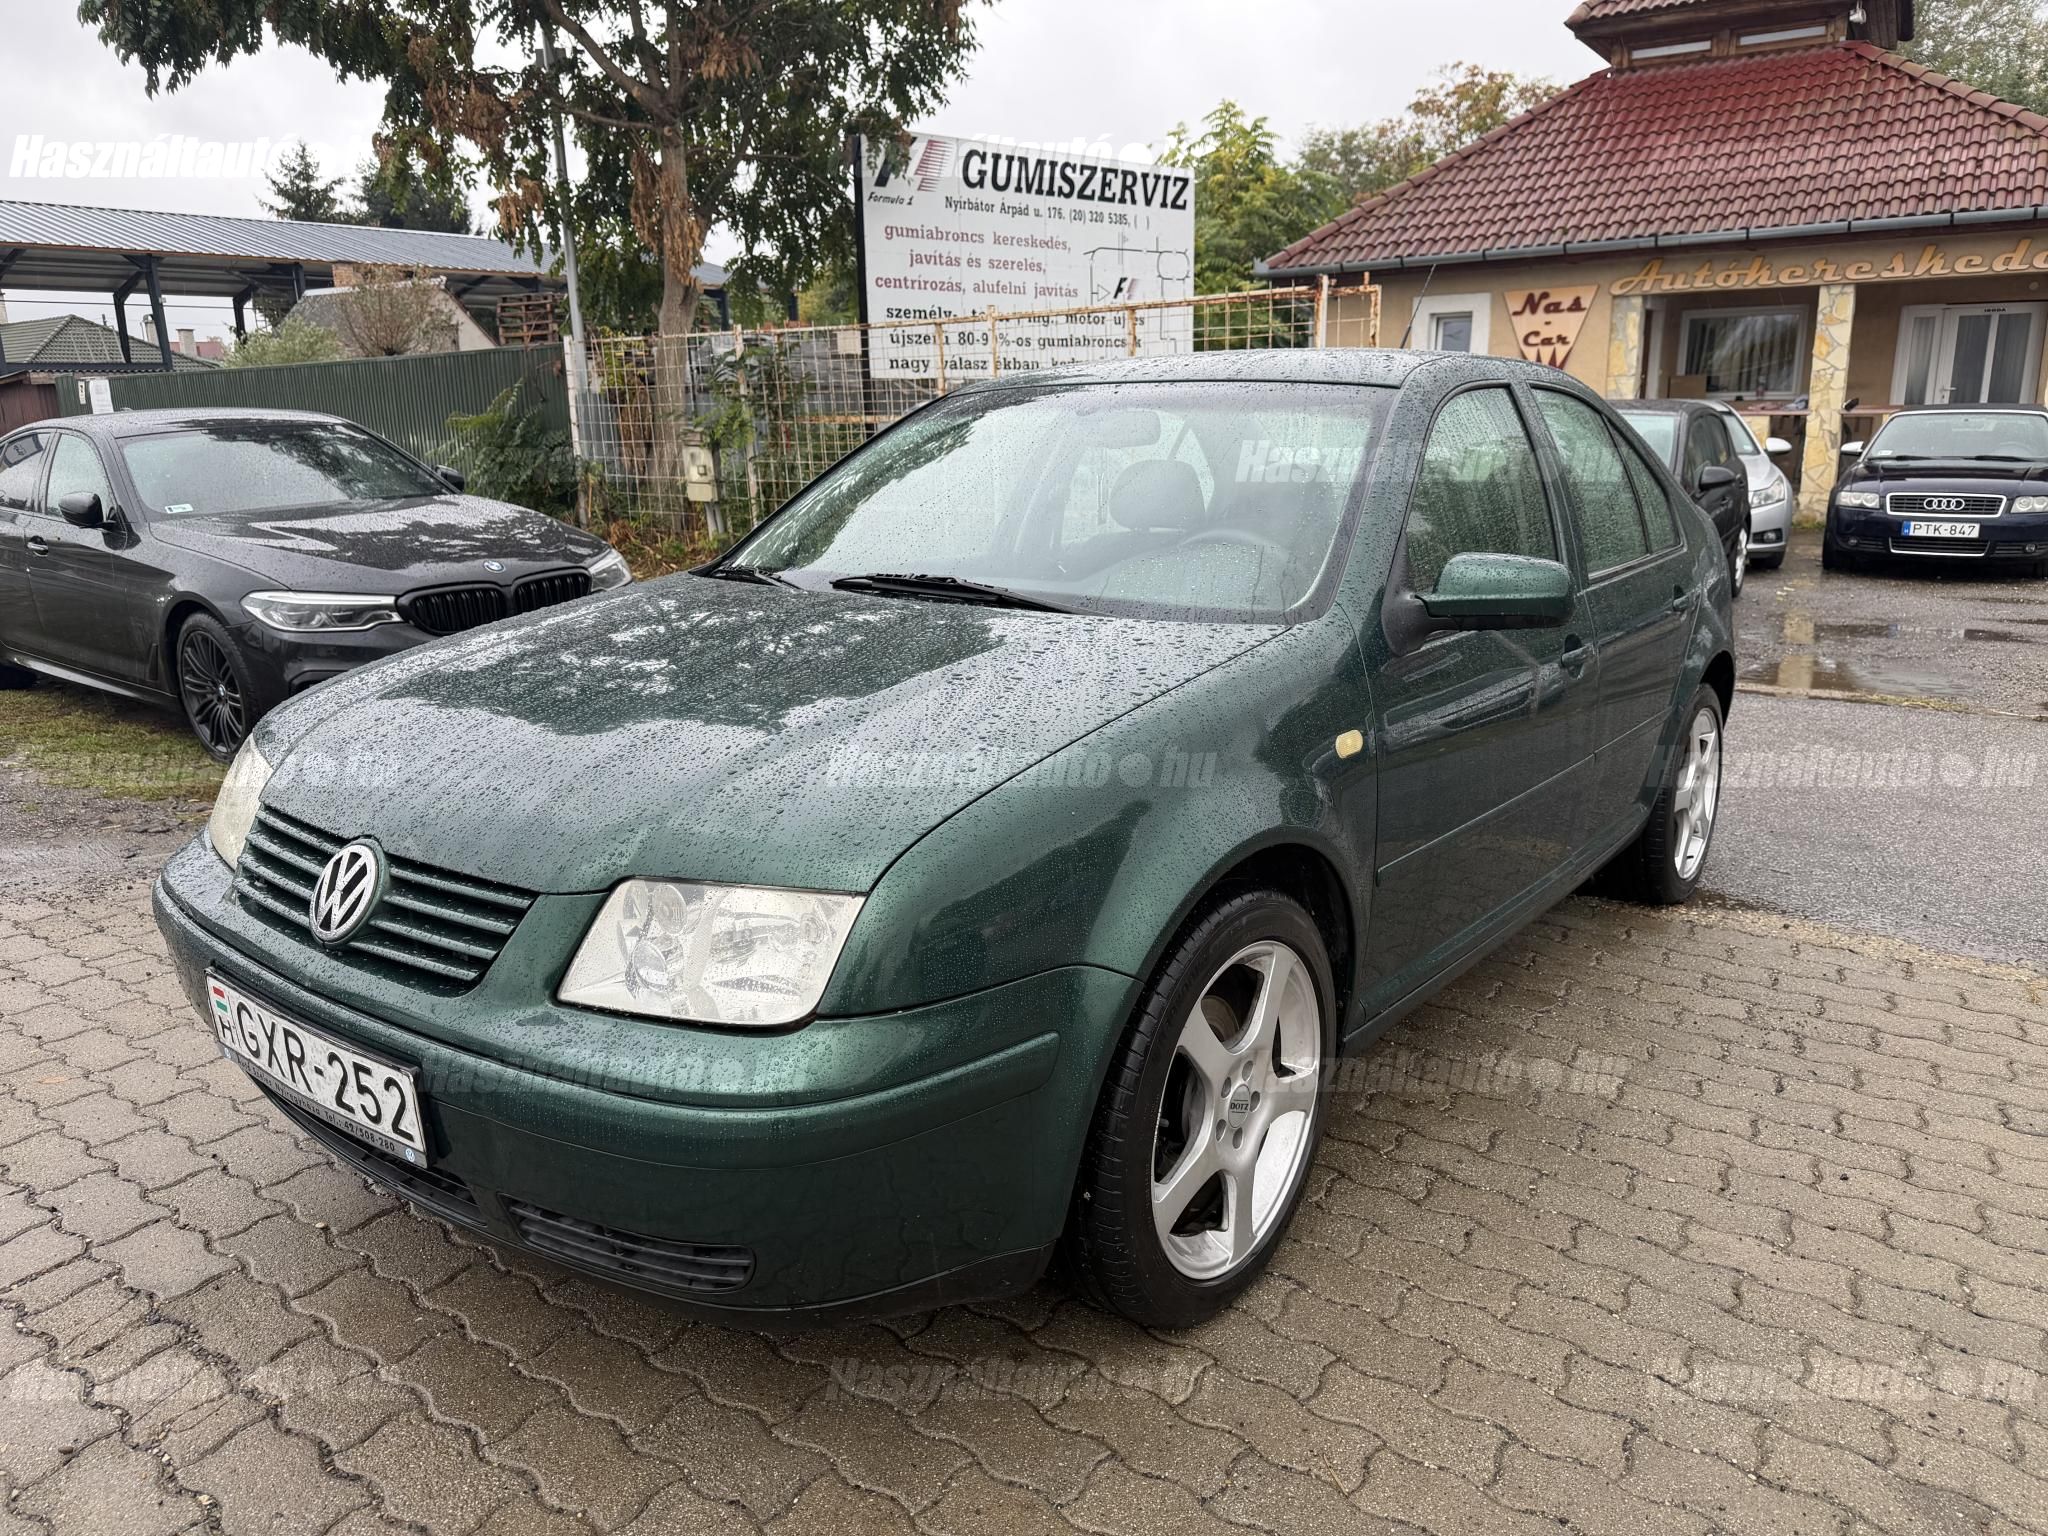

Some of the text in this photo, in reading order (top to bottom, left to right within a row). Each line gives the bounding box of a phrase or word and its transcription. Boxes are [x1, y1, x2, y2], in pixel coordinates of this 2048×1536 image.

[962, 149, 1190, 210] GUMISZERVIZ
[868, 192, 914, 206] Formula 1
[945, 196, 995, 213] Nyírbátor
[999, 197, 1029, 218] Árpád
[1034, 208, 1043, 218] u.
[1069, 208, 1086, 225] (20)
[1089, 210, 1105, 223] 320
[884, 224, 1071, 254] gumiabroncs kereskedés,
[909, 248, 1047, 275] javítás és szerelés,
[1034, 281, 1079, 299] javítás
[1512, 291, 1587, 316] Nas
[1065, 312, 1106, 325] motor
[1523, 330, 1570, 347] Car
[889, 358, 930, 373] nagy
[1912, 523, 1976, 536] PTK-847
[236, 1001, 415, 1143] GXR-252
[1230, 1102, 1249, 1111] DOTZ
